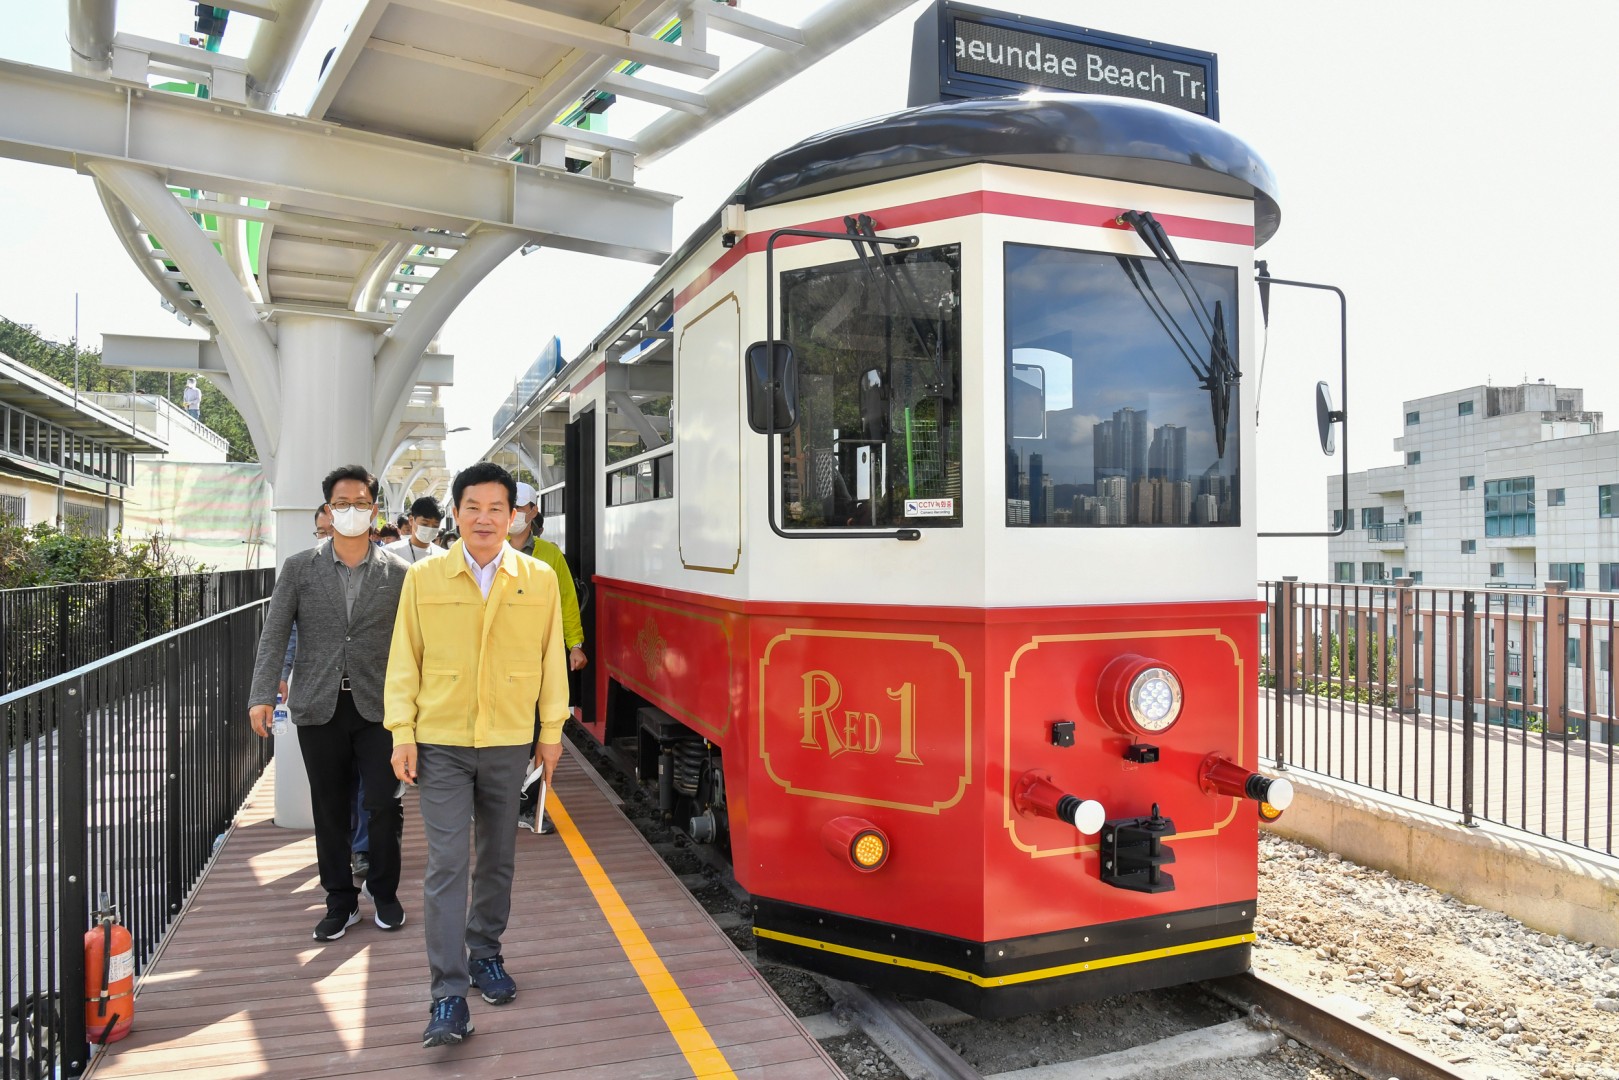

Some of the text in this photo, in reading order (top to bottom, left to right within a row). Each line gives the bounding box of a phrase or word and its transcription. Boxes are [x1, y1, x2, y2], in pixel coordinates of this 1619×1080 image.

[1086, 53, 1165, 94] Beach
[798, 669, 924, 765] RED 1
